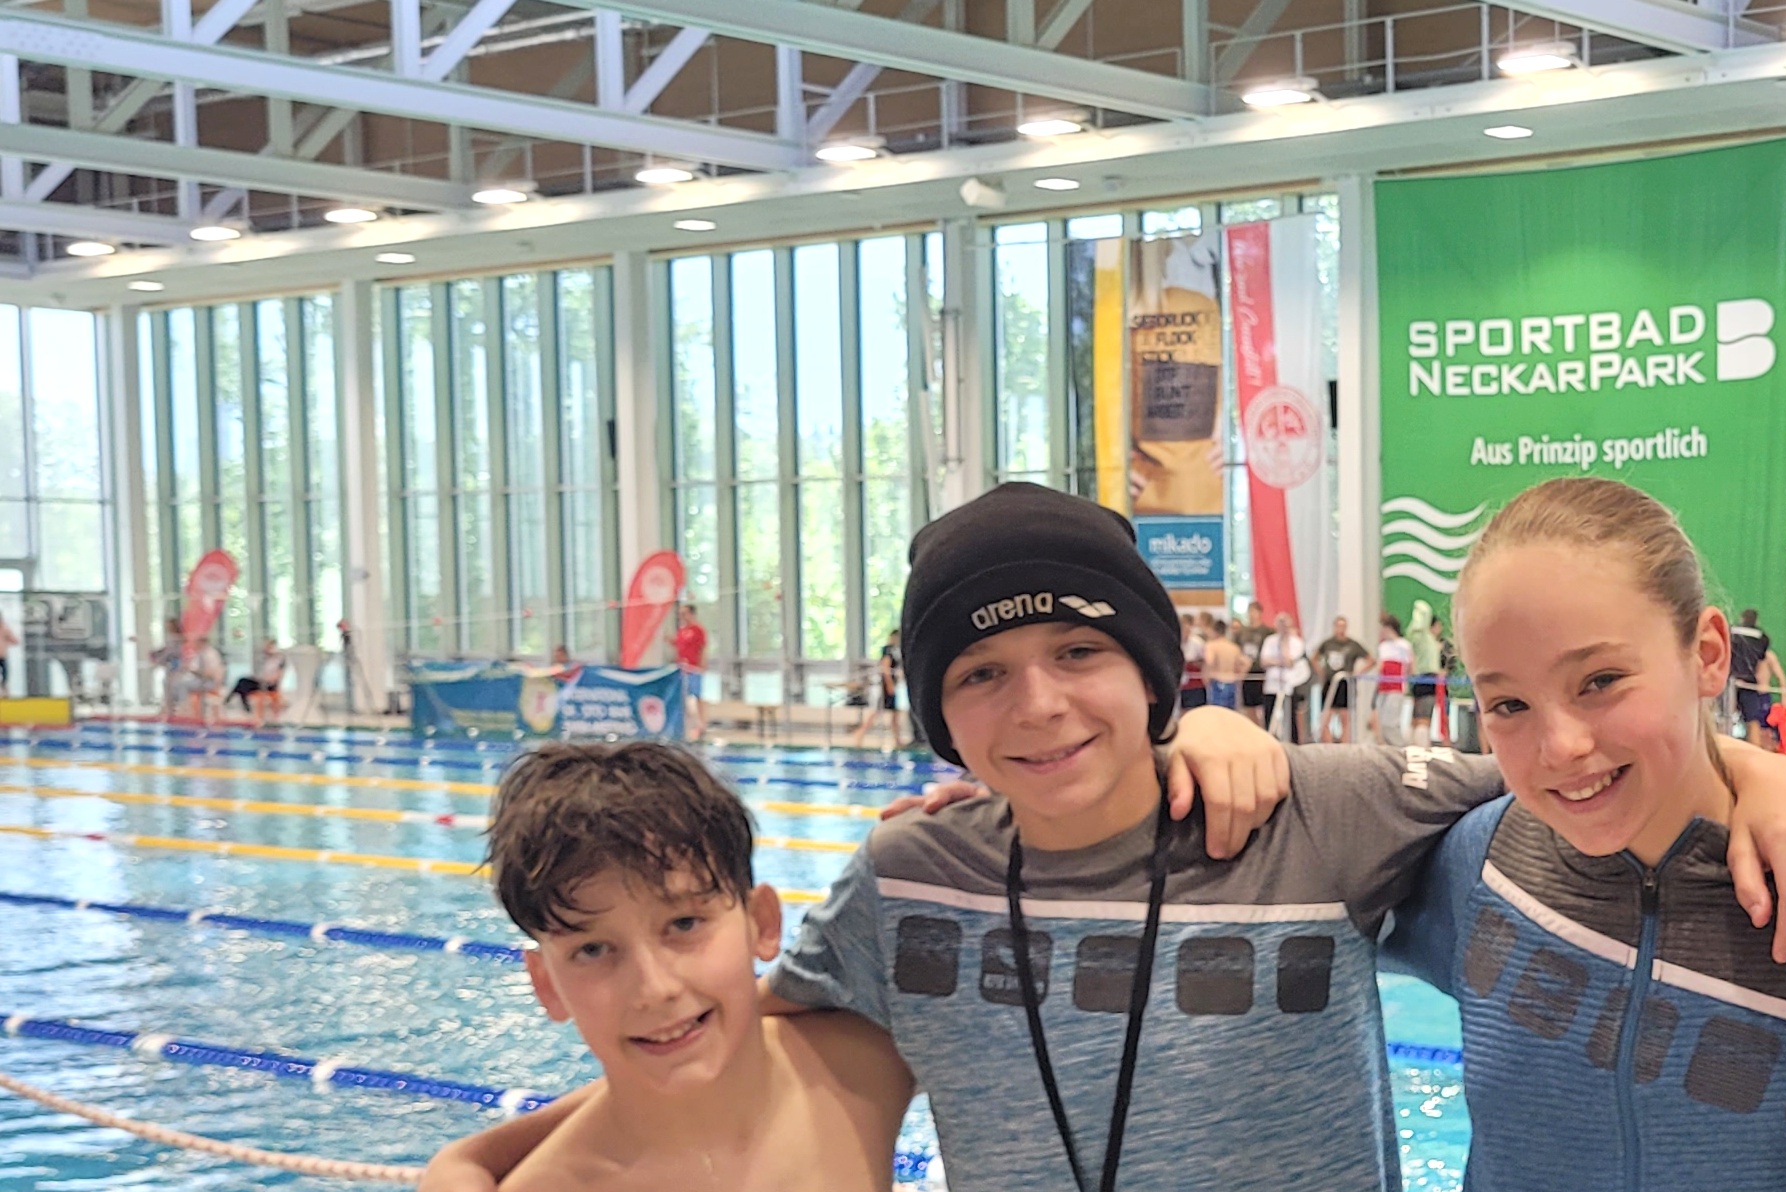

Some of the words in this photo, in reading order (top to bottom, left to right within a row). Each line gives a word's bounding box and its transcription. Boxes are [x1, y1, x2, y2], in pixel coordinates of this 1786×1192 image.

[1407, 305, 1706, 357] SPORTBAD
[1470, 436, 1513, 465] Aus
[1518, 433, 1597, 470] Prinzip
[1602, 426, 1707, 469] sportlich
[1148, 532, 1213, 555] mikado
[971, 592, 1054, 630] arena
